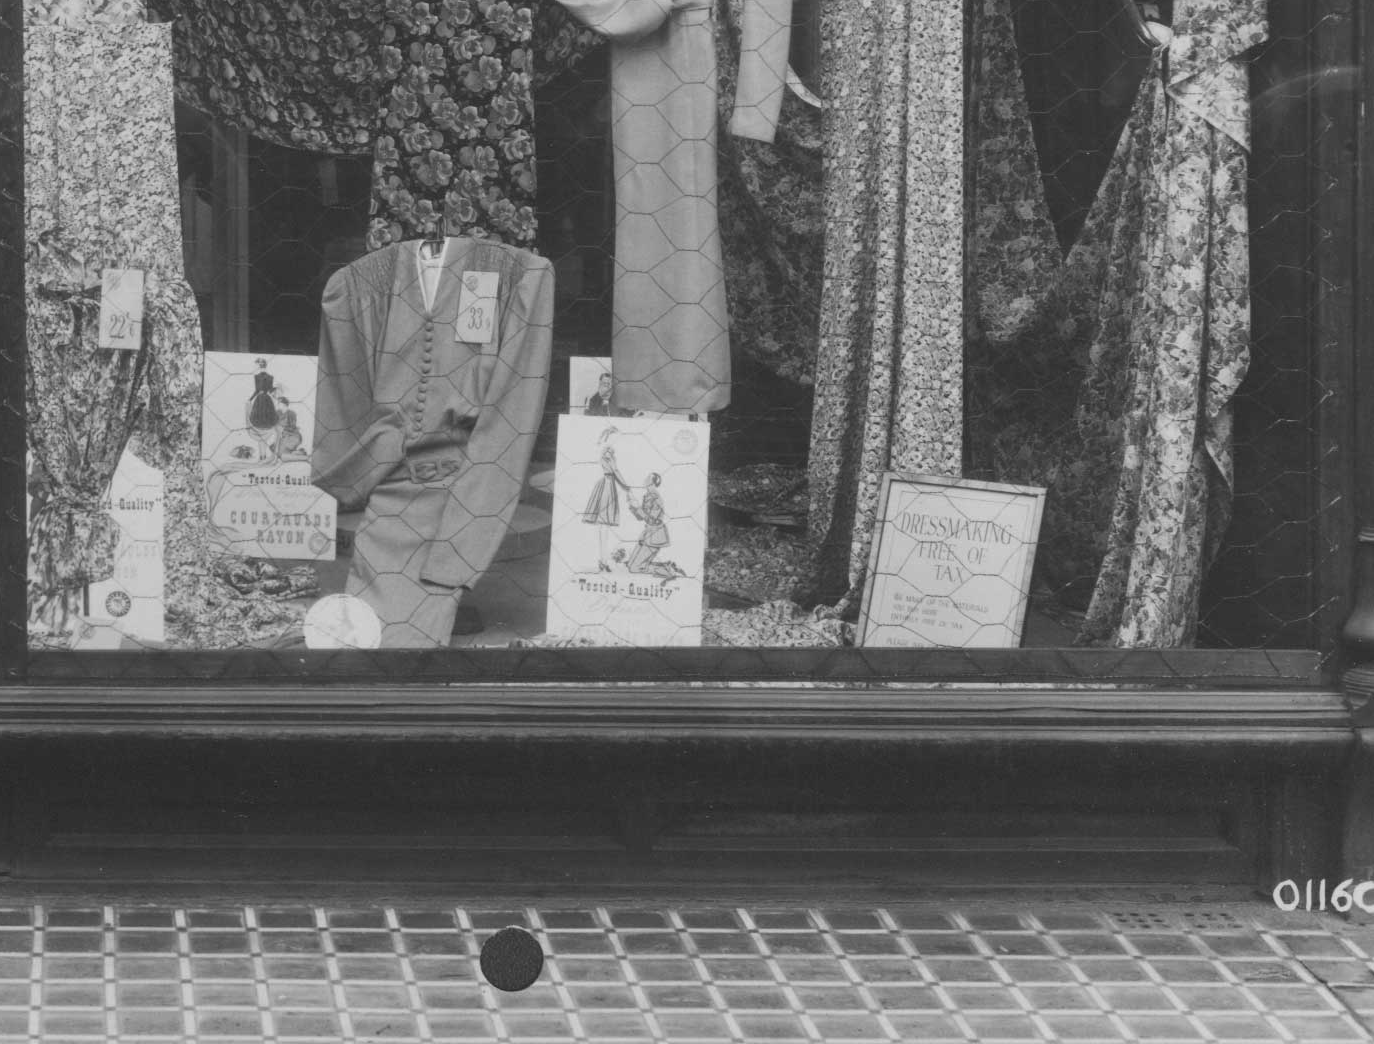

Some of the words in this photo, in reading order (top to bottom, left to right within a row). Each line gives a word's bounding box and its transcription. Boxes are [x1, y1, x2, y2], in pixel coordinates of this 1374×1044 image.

[230, 510, 332, 528] COURTAULDS
[900, 511, 1014, 545] DRESSMAKING
[257, 529, 305, 545] RAYON
[918, 542, 958, 562] FREE
[966, 546, 988, 565] OF
[933, 563, 965, 584] TAX
